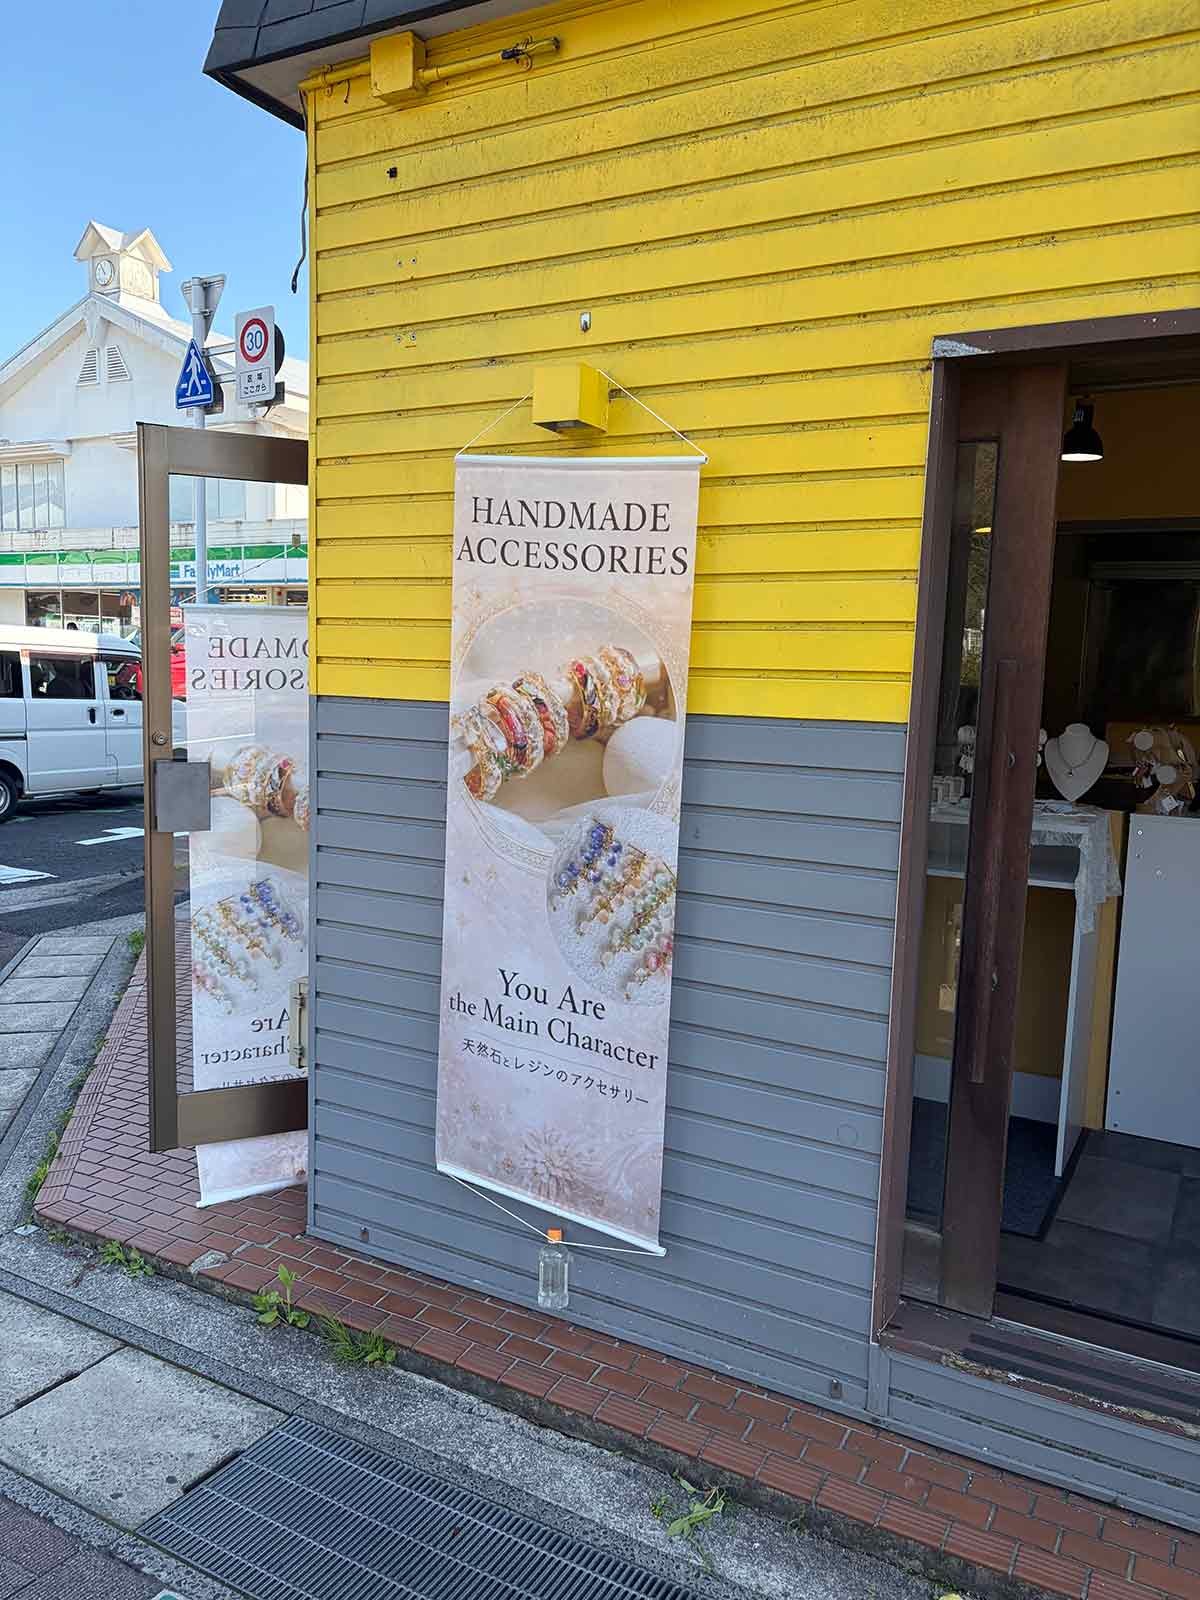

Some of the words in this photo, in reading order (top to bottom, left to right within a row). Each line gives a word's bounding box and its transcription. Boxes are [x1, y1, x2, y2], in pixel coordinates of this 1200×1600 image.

[246, 330, 263, 351] 30
[471, 496, 671, 532] HANDMADE
[183, 563, 241, 579] FalyMart
[456, 535, 689, 576] ACCESSORIES
[499, 968, 548, 1005] You
[557, 985, 606, 1020] Are
[449, 991, 477, 1016] the
[483, 997, 539, 1036] Main
[547, 1017, 660, 1070] Character
[462, 1038, 649, 1104] 天然石とレジンのアクセサリー
